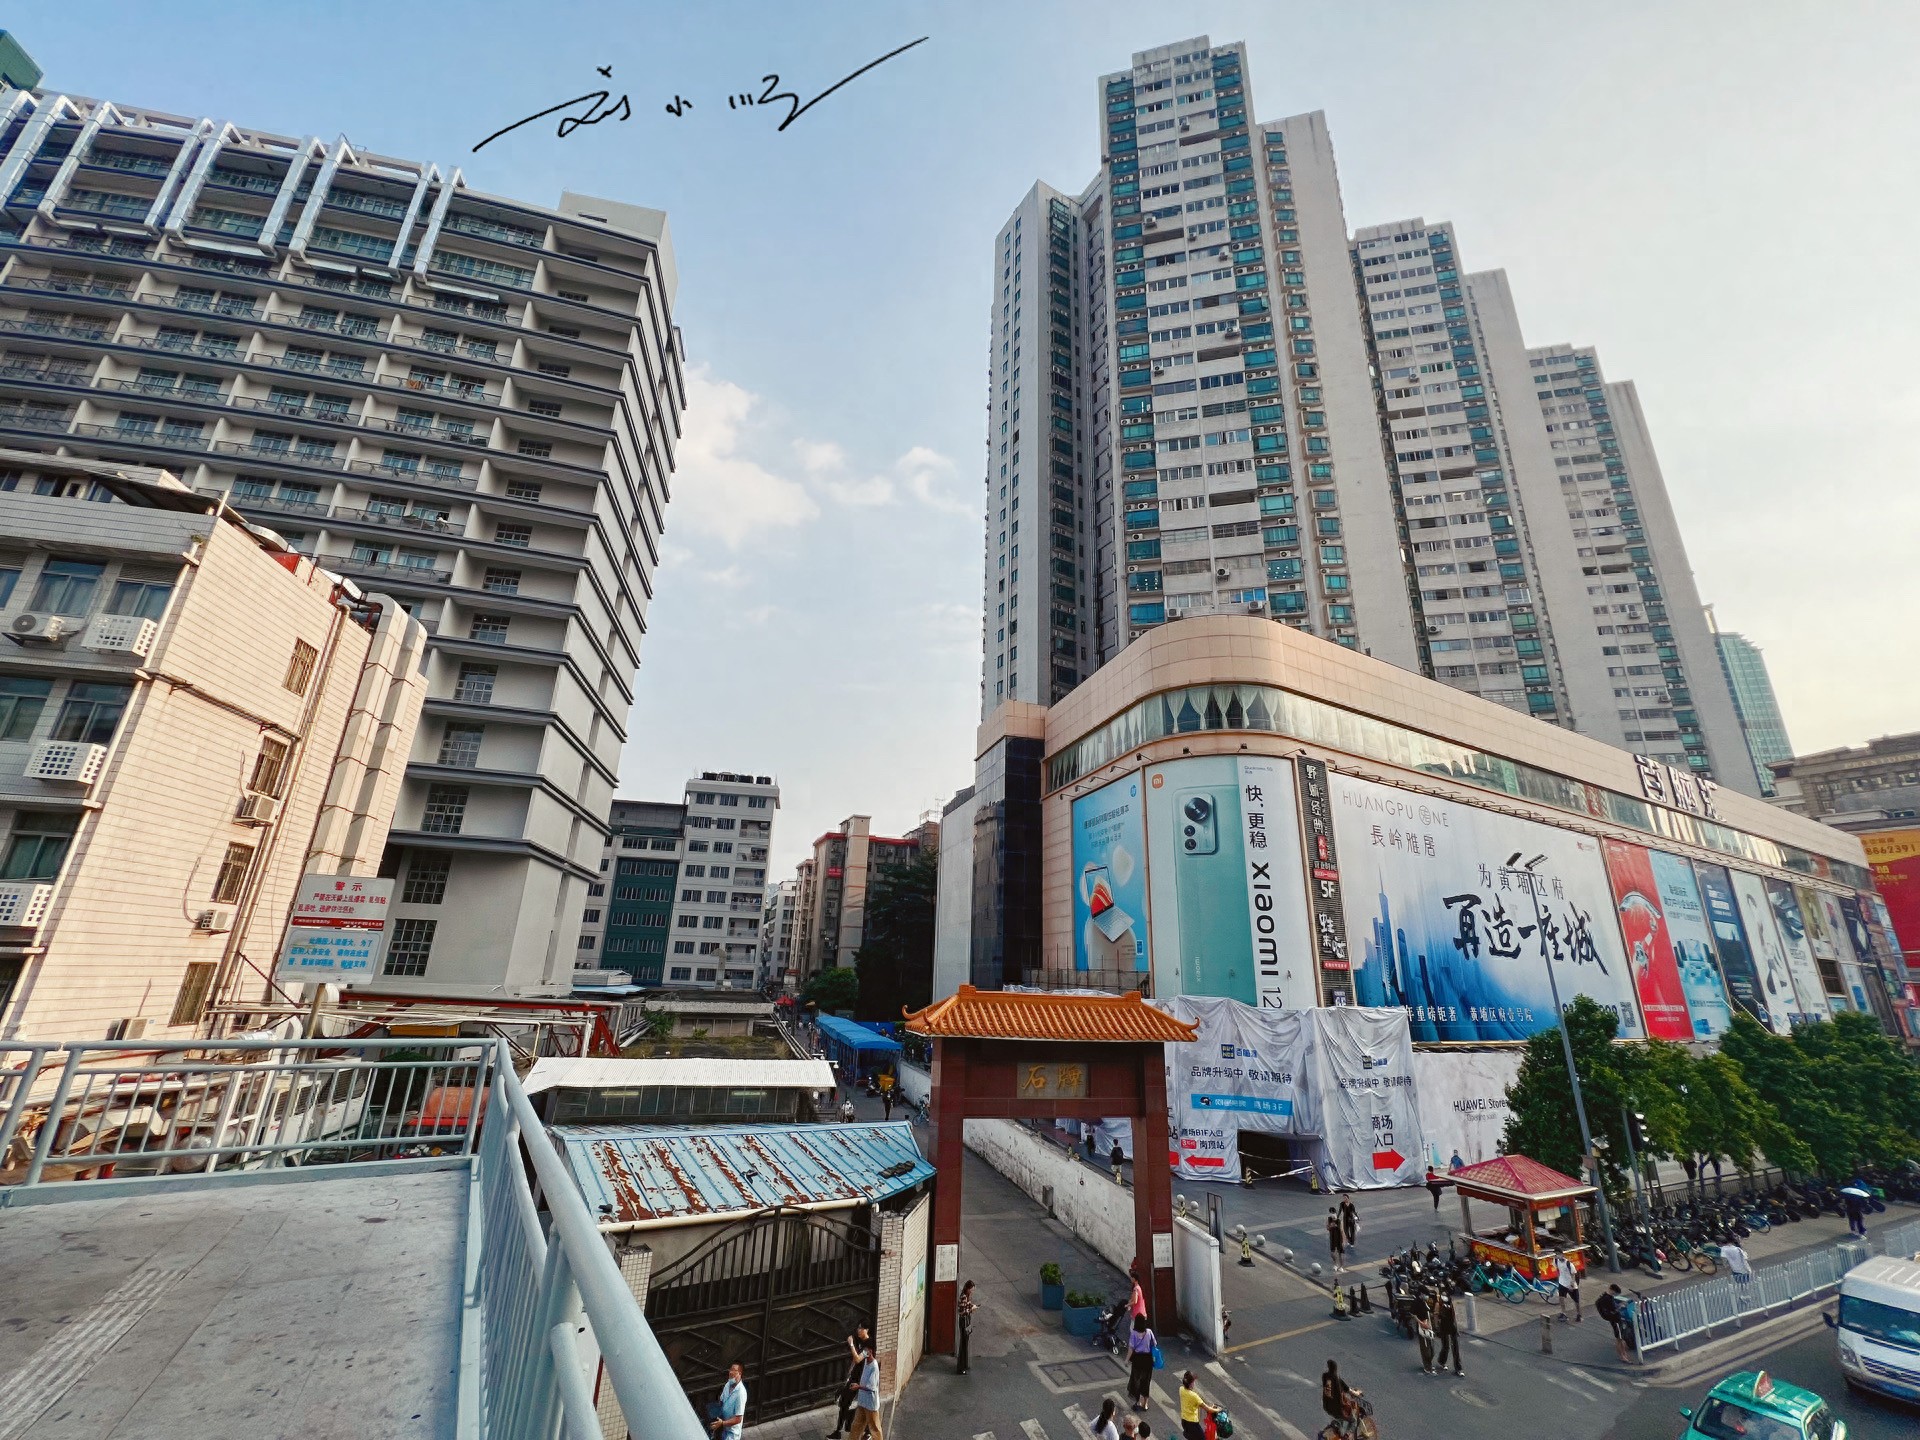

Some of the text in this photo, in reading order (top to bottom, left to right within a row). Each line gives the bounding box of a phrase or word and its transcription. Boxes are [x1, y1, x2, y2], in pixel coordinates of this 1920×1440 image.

[1634, 754, 1727, 822] 百脑汇
[1343, 790, 1413, 820] HUANGPU
[335, 881, 362, 891] 警示
[1320, 880, 1335, 898] 5F
[1478, 863, 1564, 900] 为黄埔区府
[1442, 892, 1609, 976] 再造一座城
[1263, 987, 1283, 1009] 12
[1469, 1006, 1534, 1022] 黄埔区府壹号院
[1021, 1065, 1083, 1093] 石牌
[1191, 1066, 1292, 1084] 品牌升级中 敬请期待
[1341, 1076, 1412, 1088] 品牌升级中 敬请期待
[1254, 1101, 1283, 1111] 商场3F
[1453, 1098, 1487, 1112] HUAWEI
[1371, 1115, 1393, 1130] 商场
[1181, 1128, 1223, 1137] 商场B1F入口
[1374, 1133, 1394, 1147] 入口
[1200, 1140, 1224, 1149] 岗顶站
